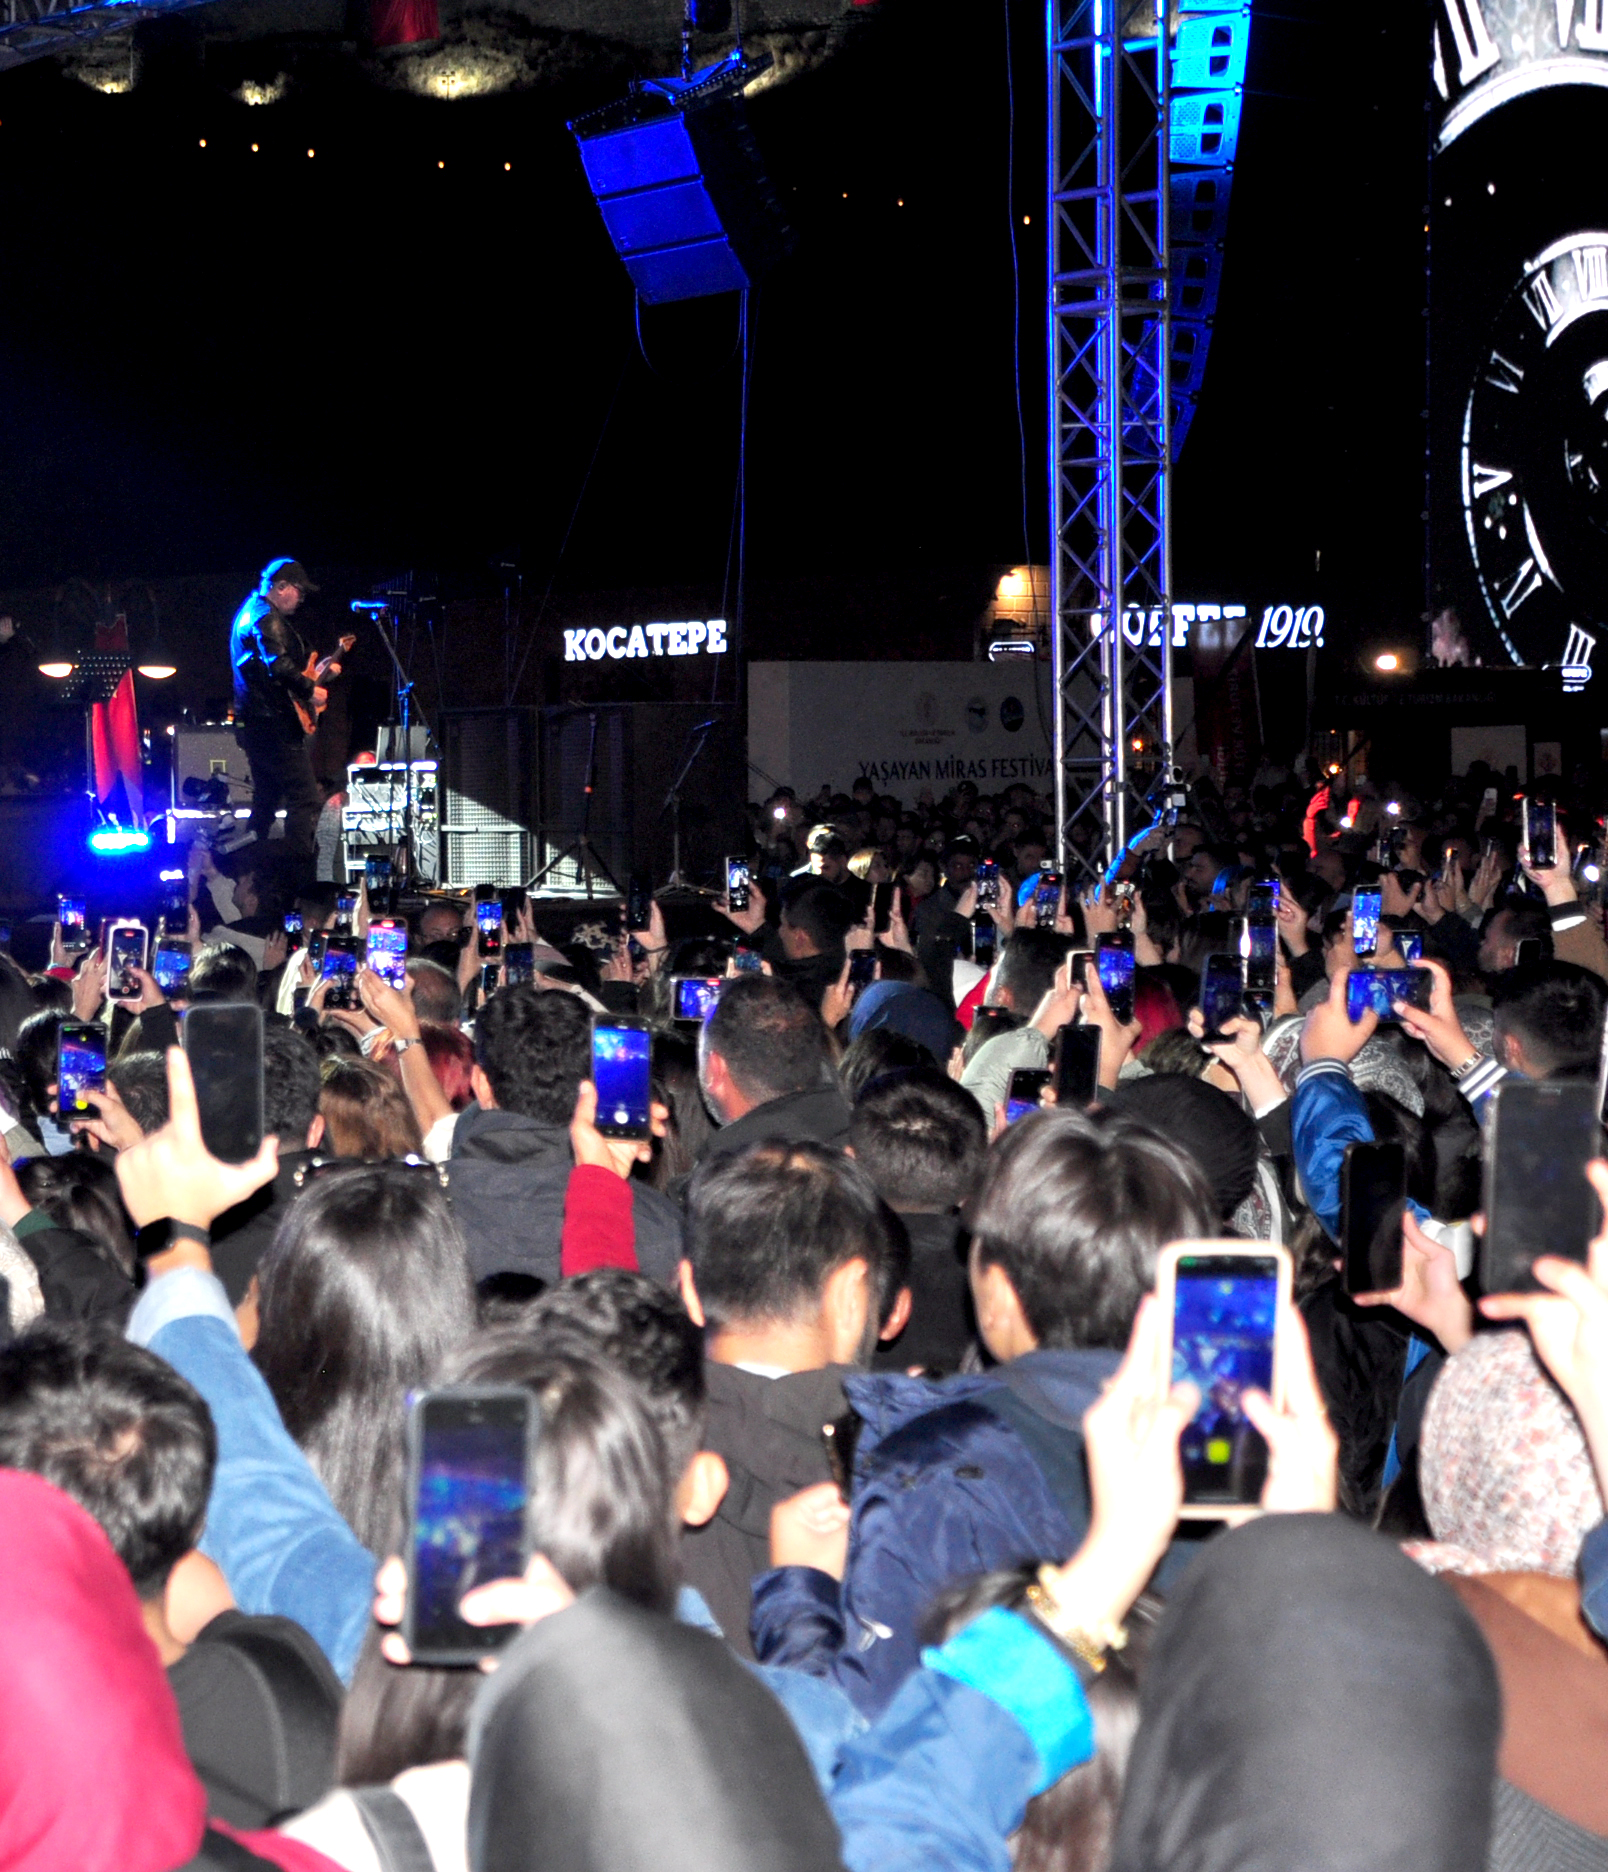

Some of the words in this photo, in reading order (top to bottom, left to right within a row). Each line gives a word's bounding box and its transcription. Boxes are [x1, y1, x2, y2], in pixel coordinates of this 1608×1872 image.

[563, 619, 728, 662] KOCATEPE
[859, 759, 931, 787] YAŞAYAN
[936, 754, 987, 780] MİRAS
[992, 753, 1054, 779] FESTİVA
